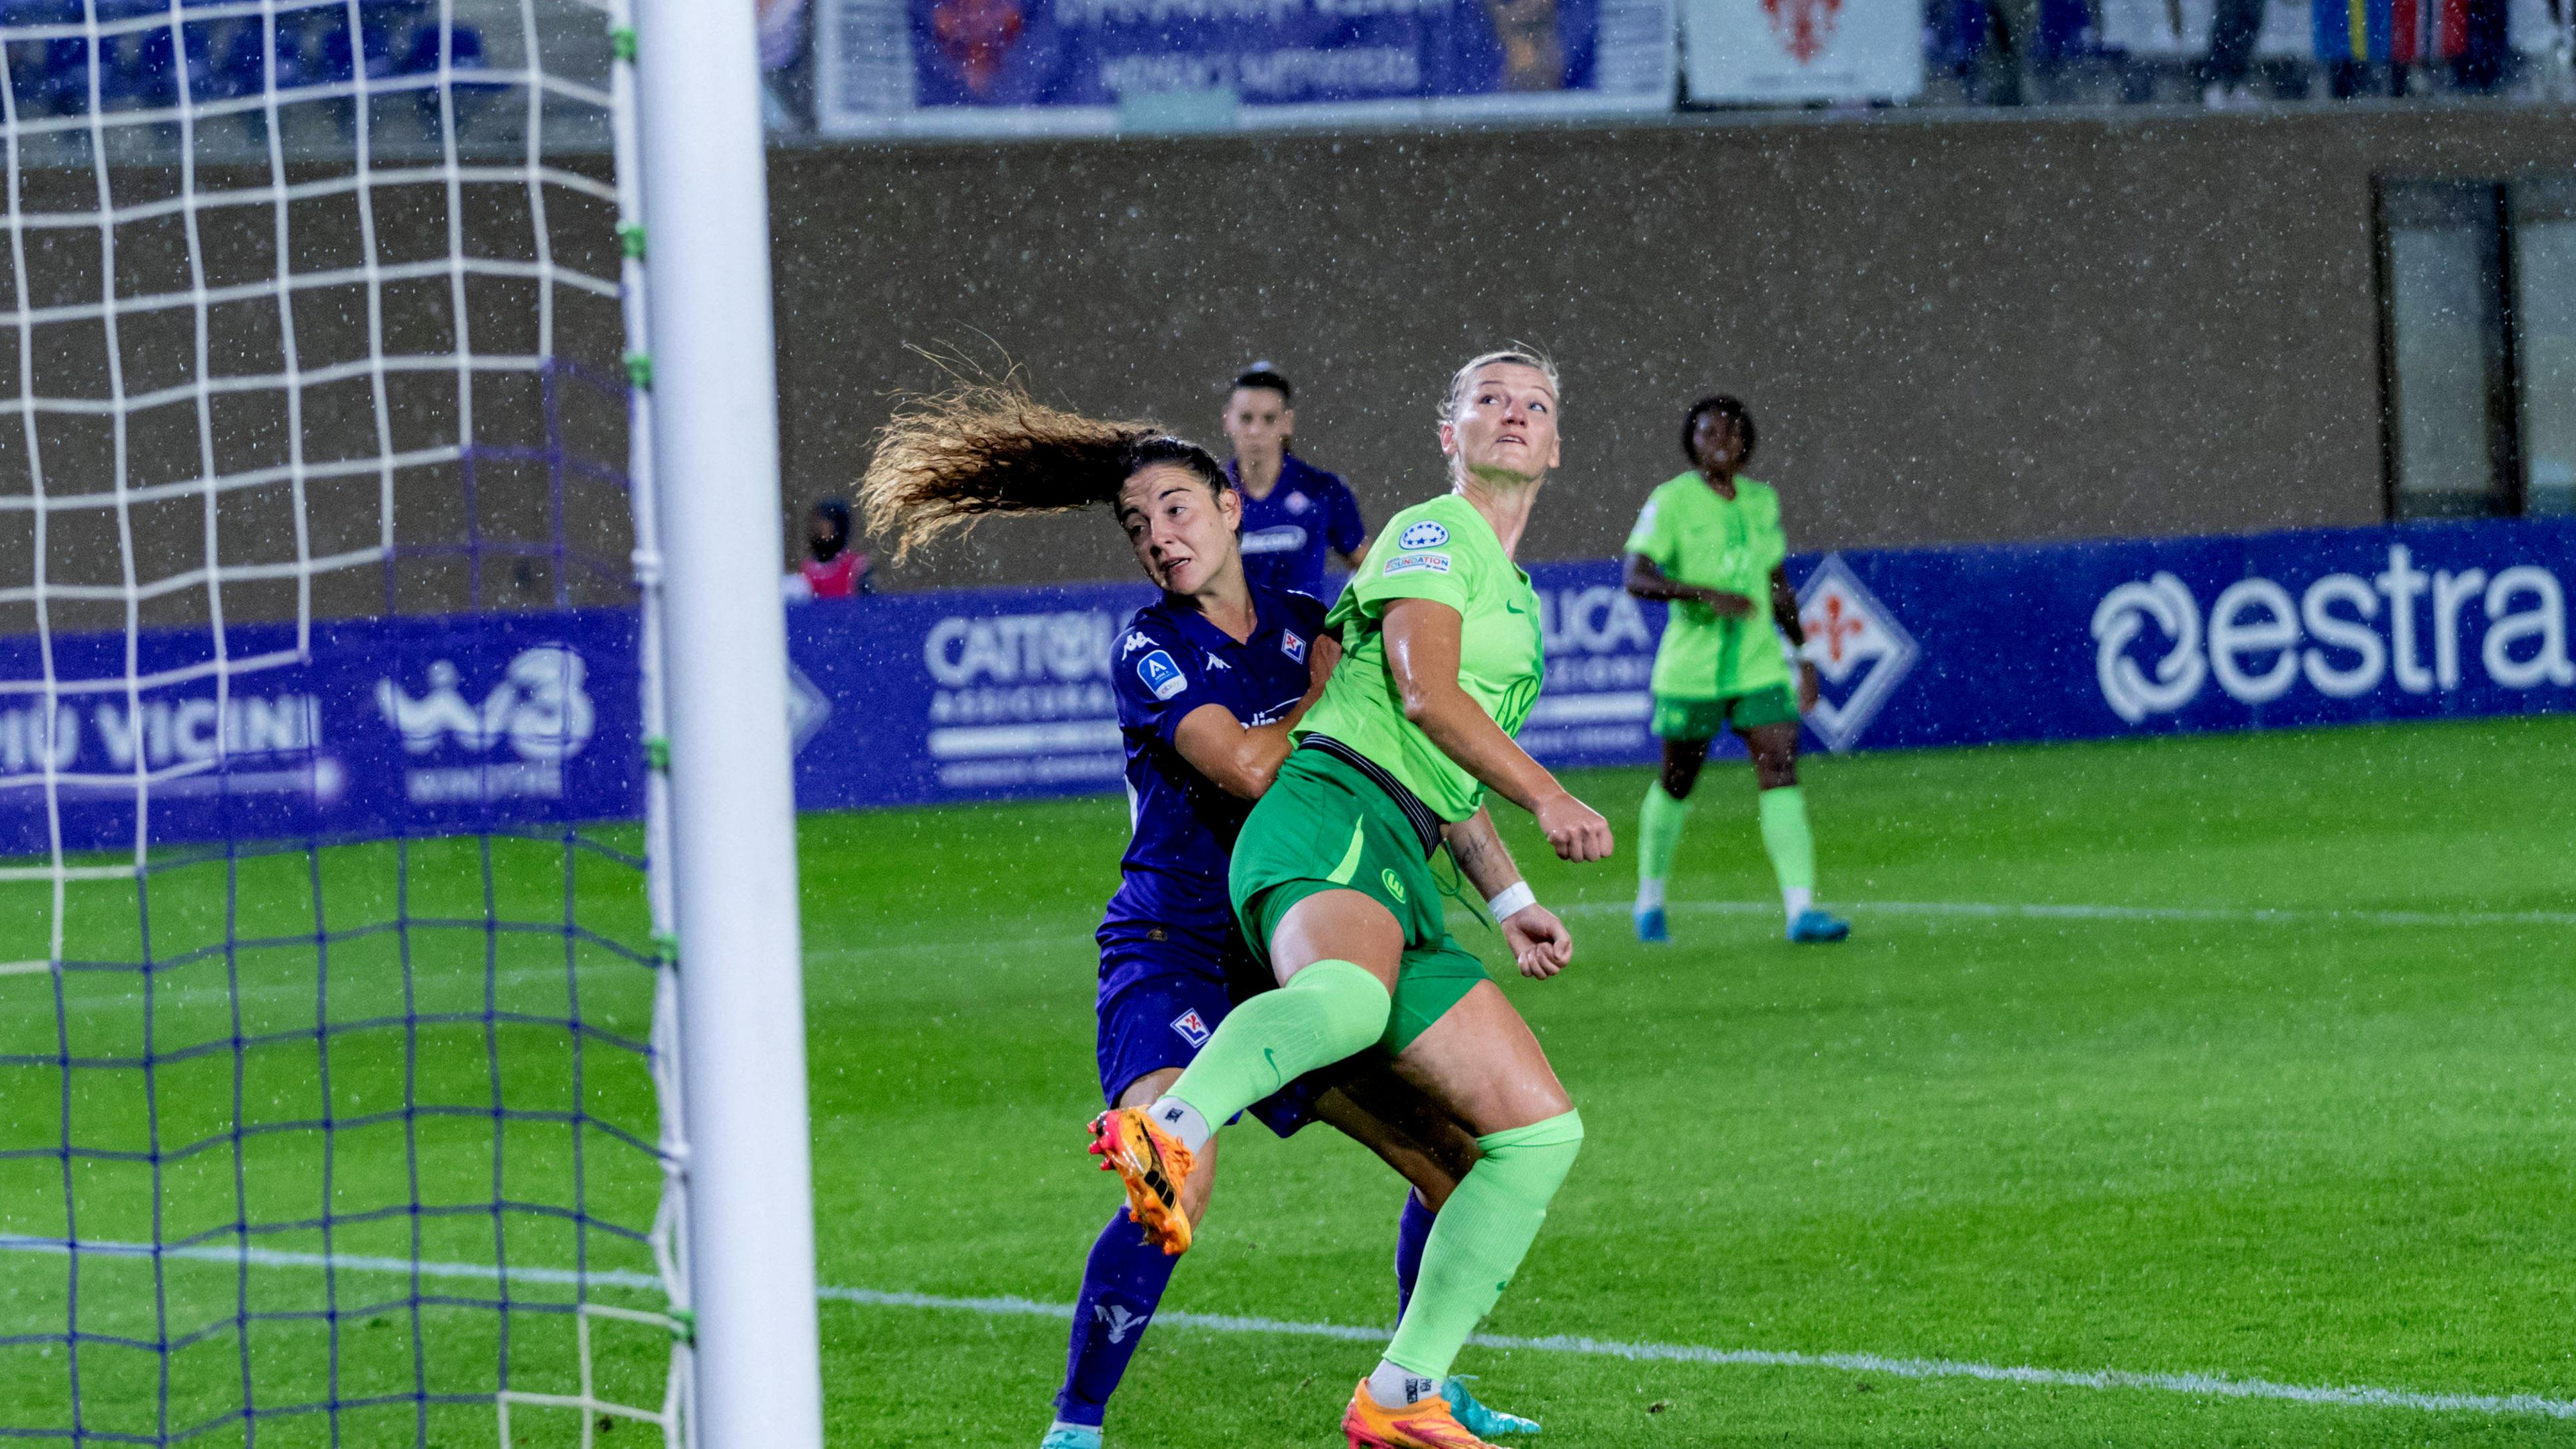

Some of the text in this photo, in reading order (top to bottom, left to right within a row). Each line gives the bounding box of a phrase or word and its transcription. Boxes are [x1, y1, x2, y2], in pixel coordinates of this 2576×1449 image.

[1385, 555, 1448, 570] FOUNDATION
[924, 612, 1116, 686] CATTOL
[2208, 543, 2576, 703] estra
[95, 693, 321, 768] VICINI
